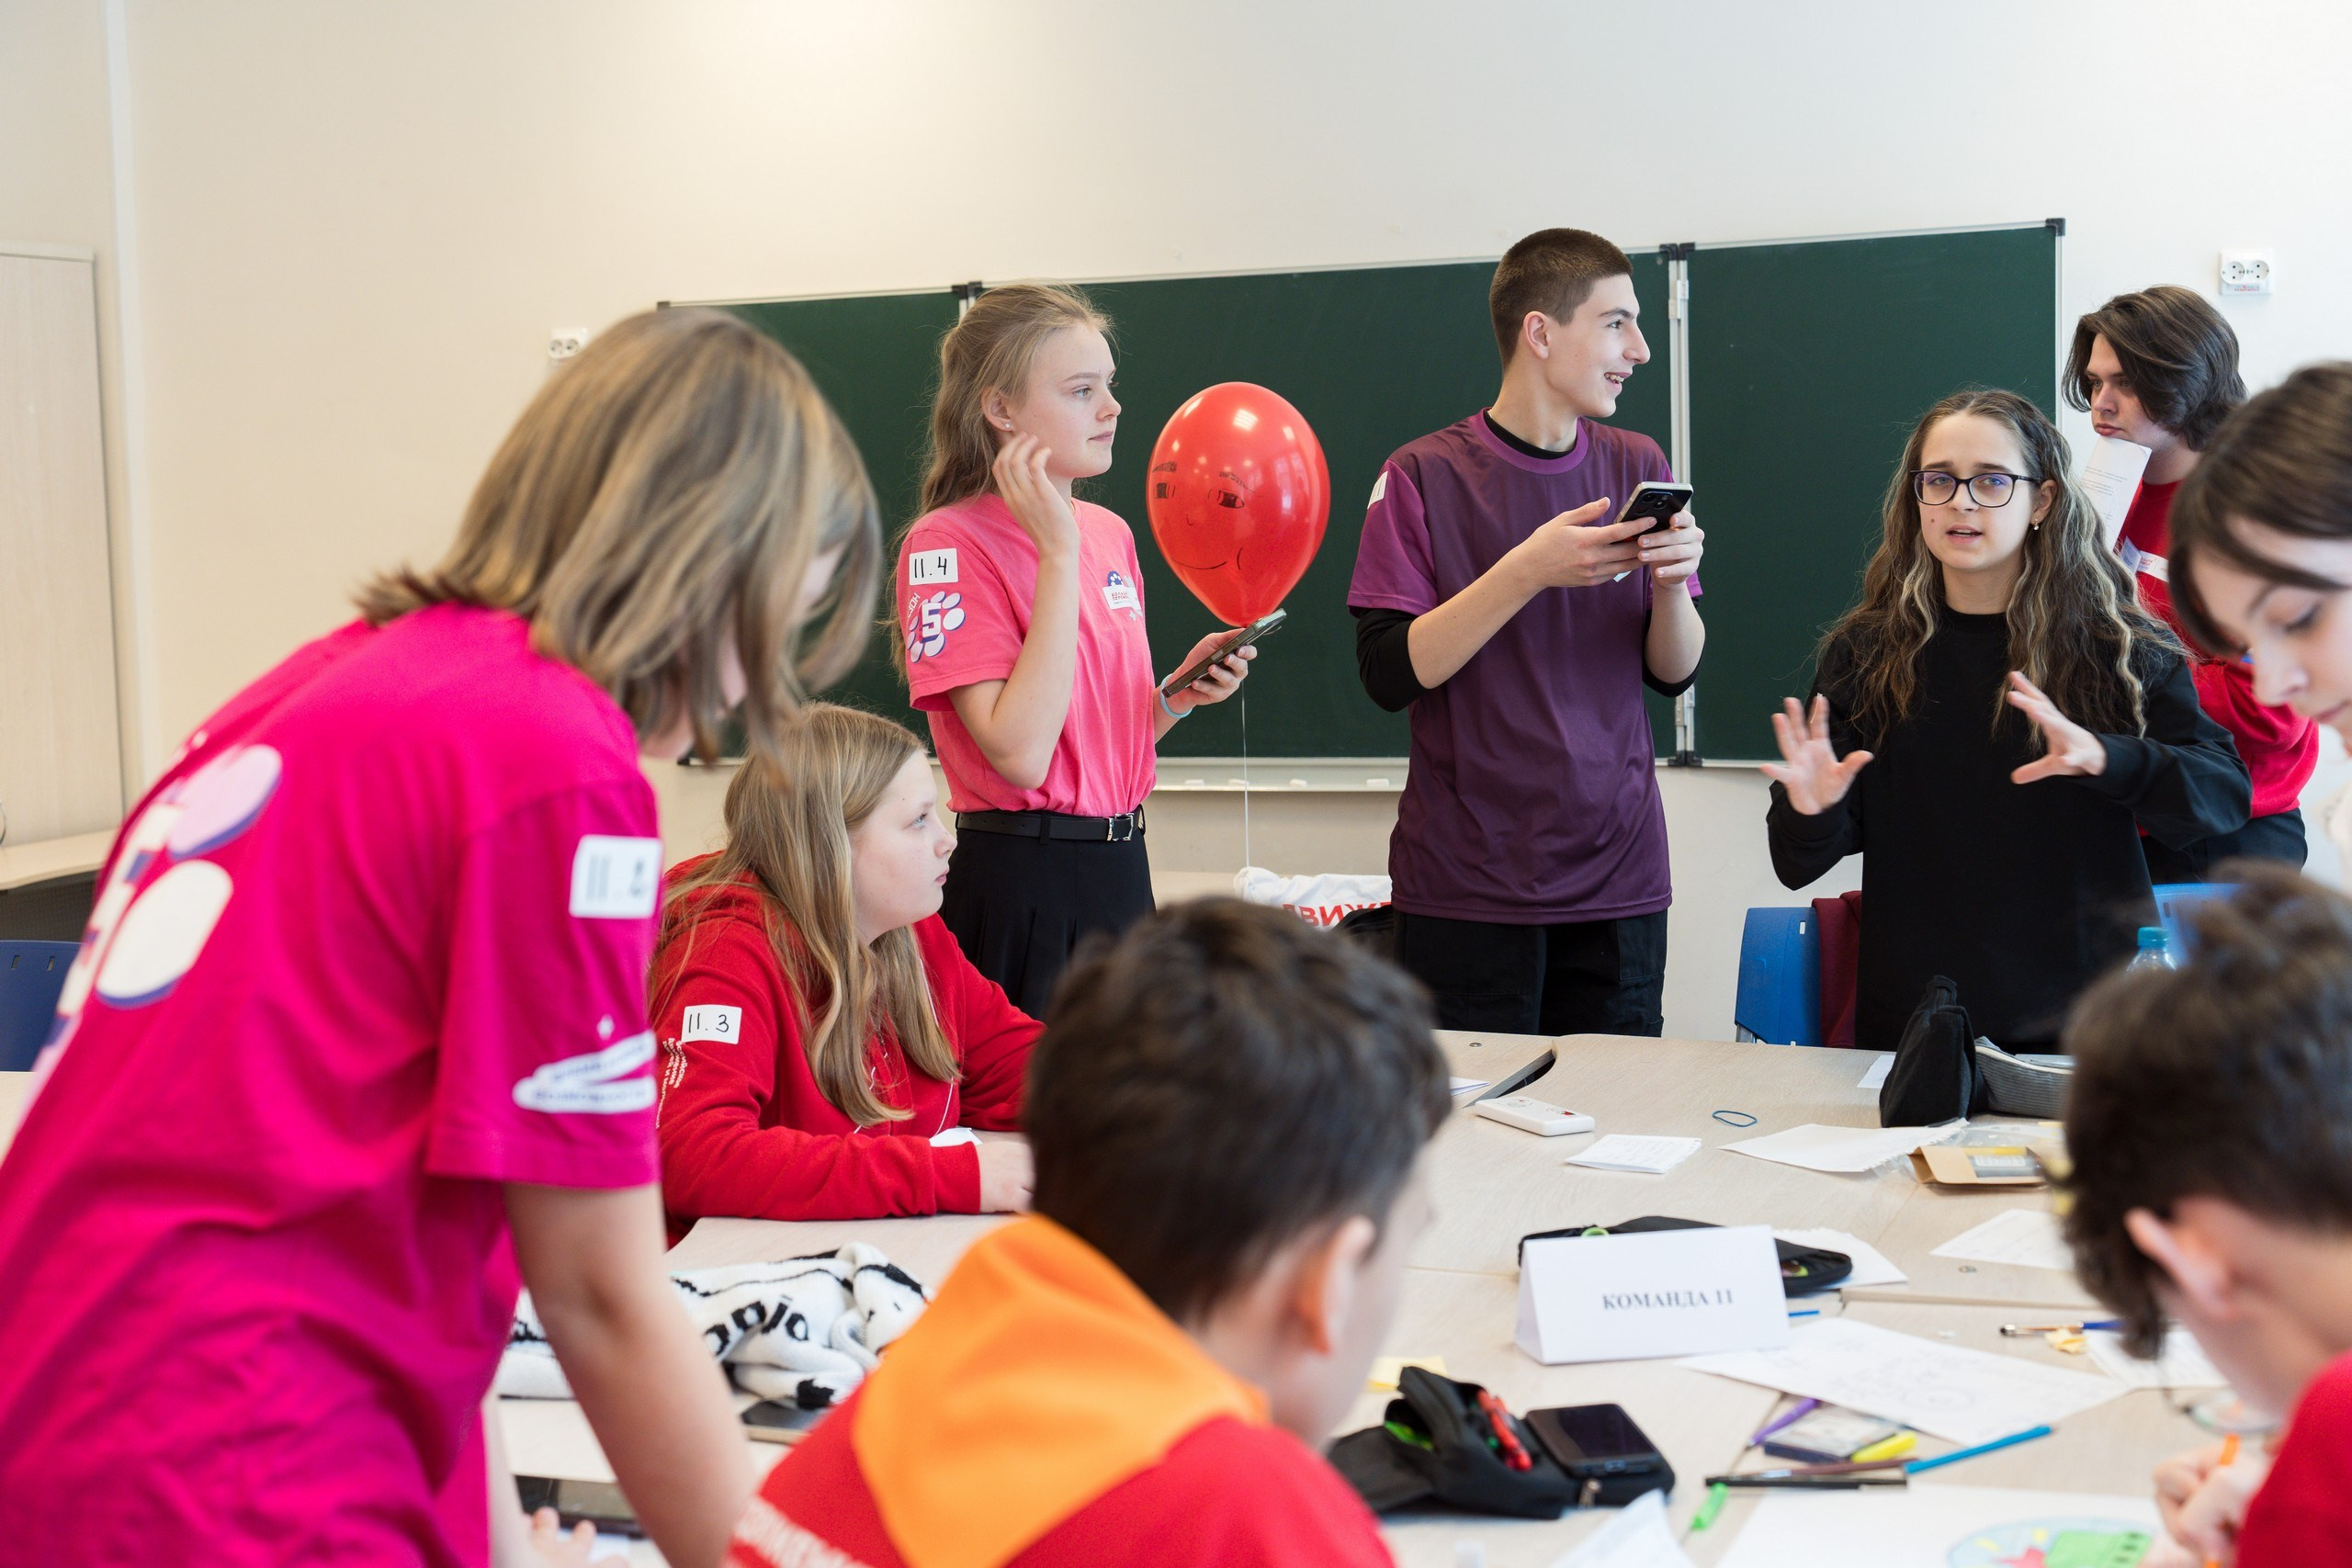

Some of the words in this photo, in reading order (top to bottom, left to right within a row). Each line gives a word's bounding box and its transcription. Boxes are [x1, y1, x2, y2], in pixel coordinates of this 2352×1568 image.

[914, 556, 947, 578] 11.4
[922, 602, 942, 640] 5
[688, 1012, 729, 1033] 11.3
[673, 1039, 688, 1089] оссийское
[1601, 1290, 1710, 1311] КОМАНДА
[1715, 1289, 1734, 1304] 11
